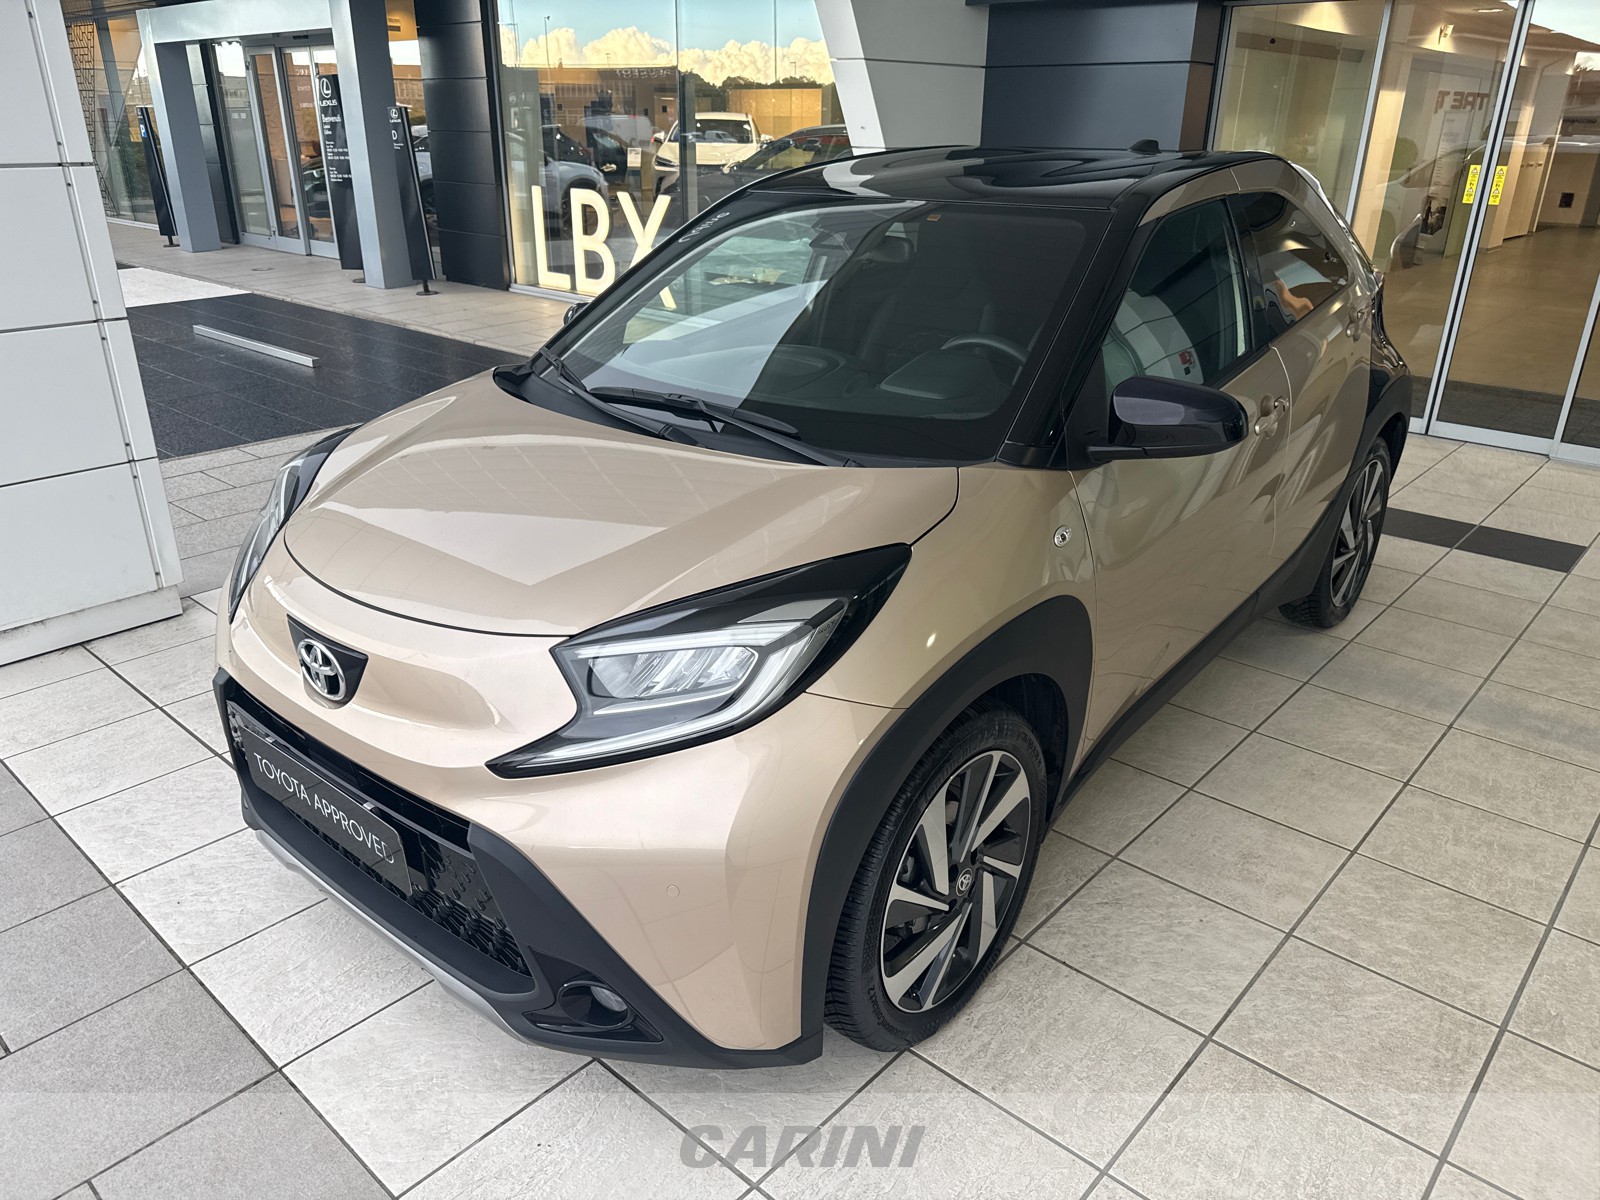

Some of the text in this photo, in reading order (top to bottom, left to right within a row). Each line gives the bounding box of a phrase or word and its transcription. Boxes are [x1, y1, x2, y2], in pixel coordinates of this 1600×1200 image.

[320, 99, 338, 107] LEXUS
[391, 130, 398, 140] D
[531, 185, 676, 309] LBX
[253, 752, 311, 806] TOYOTA
[314, 793, 395, 864] APPROVED
